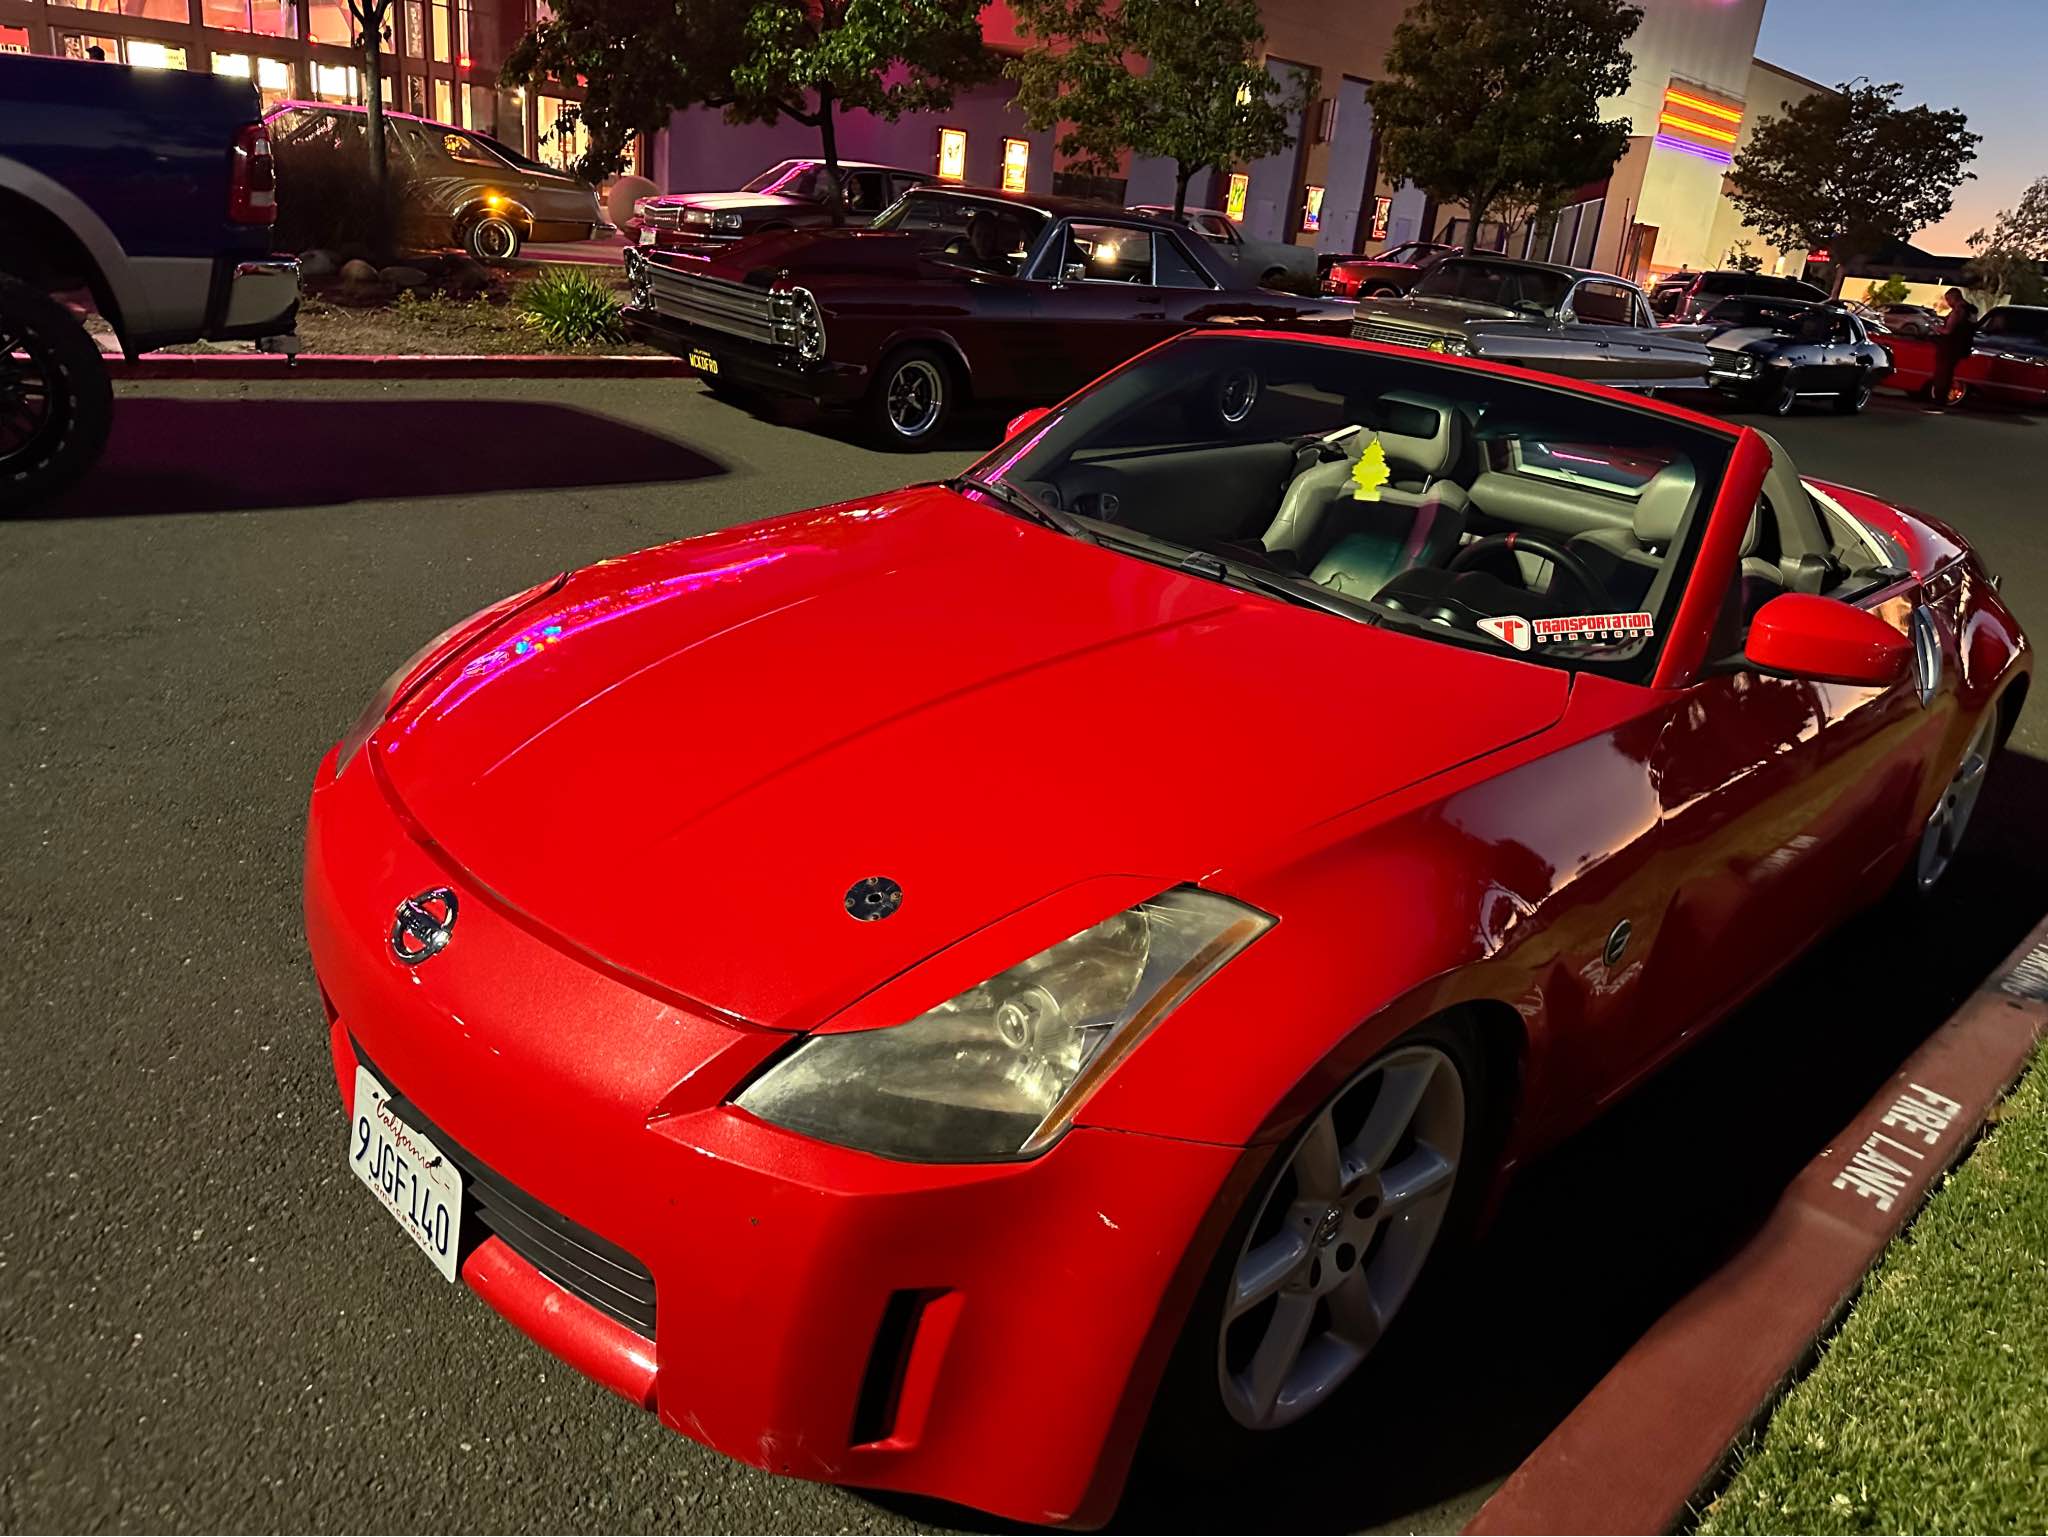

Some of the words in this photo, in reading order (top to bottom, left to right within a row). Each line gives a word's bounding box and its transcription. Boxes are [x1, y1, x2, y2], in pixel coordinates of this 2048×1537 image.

[1537, 630, 1654, 642] SERVICES
[376, 1098, 438, 1182] California
[1881, 1082, 1963, 1145] FIRE
[355, 1116, 450, 1256] 9JGF140
[1831, 1131, 1925, 1213] LANE
